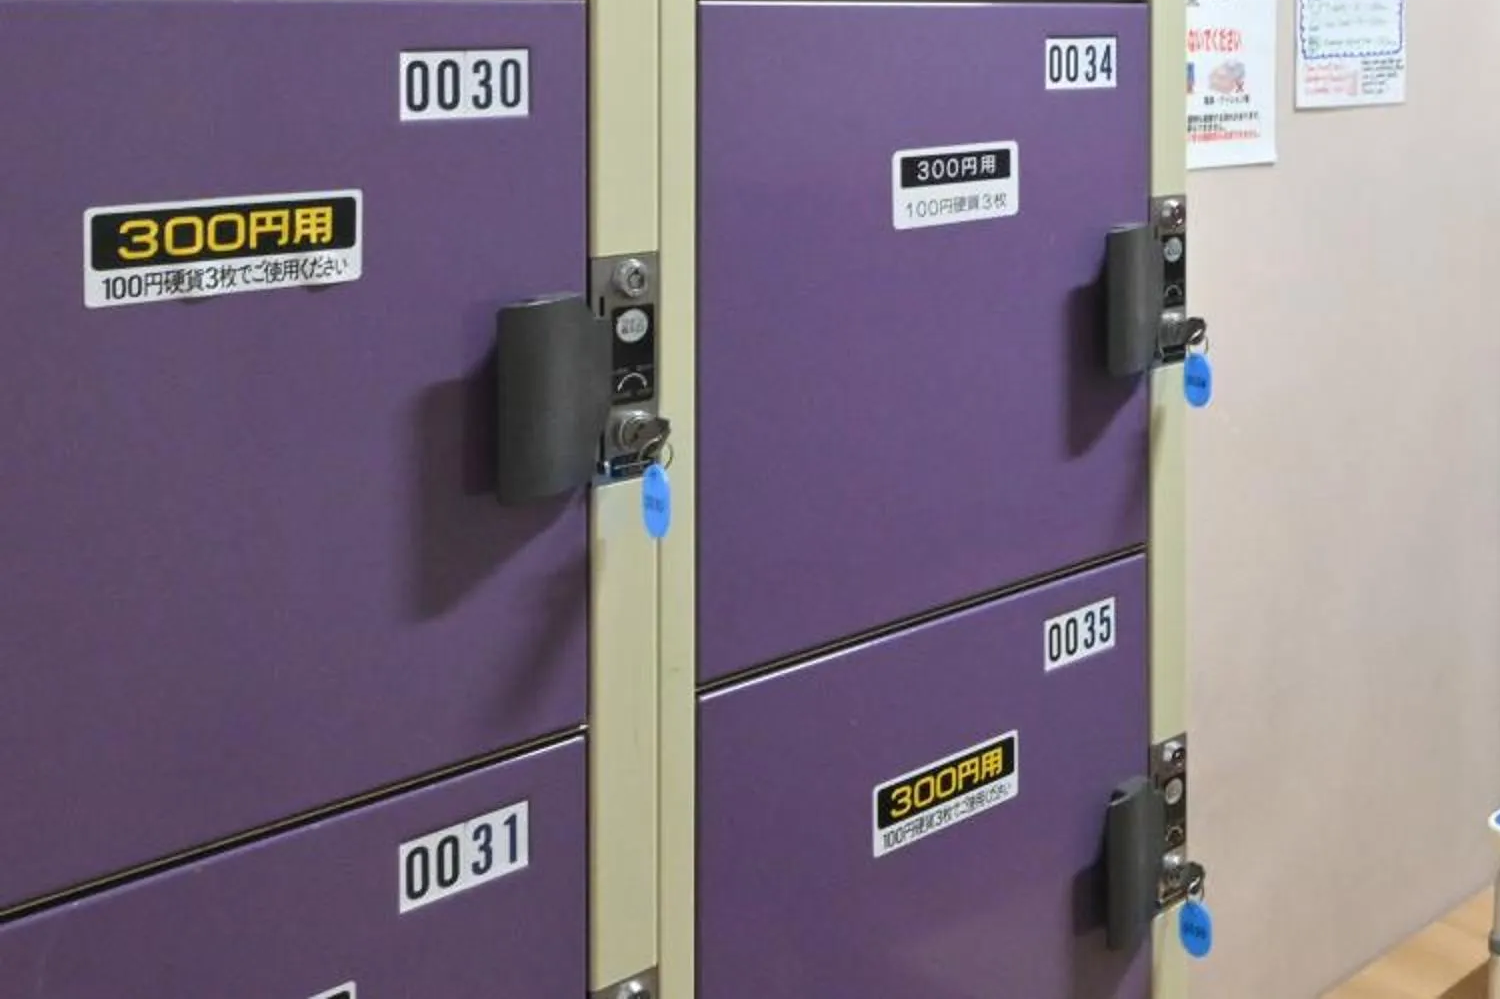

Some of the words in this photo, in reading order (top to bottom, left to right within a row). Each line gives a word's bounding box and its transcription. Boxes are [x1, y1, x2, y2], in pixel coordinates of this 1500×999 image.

[405, 58, 522, 112] 0030
[1049, 44, 1113, 83] 0034
[916, 154, 997, 181] 300円用
[906, 192, 1007, 218] 100円硬貨3枚
[116, 204, 334, 261] 300円用
[101, 256, 349, 301] 100円硬貨3枚でご使用ください
[1049, 604, 1112, 663] 0035
[889, 746, 1004, 819] 300円用
[405, 813, 519, 901] 0031
